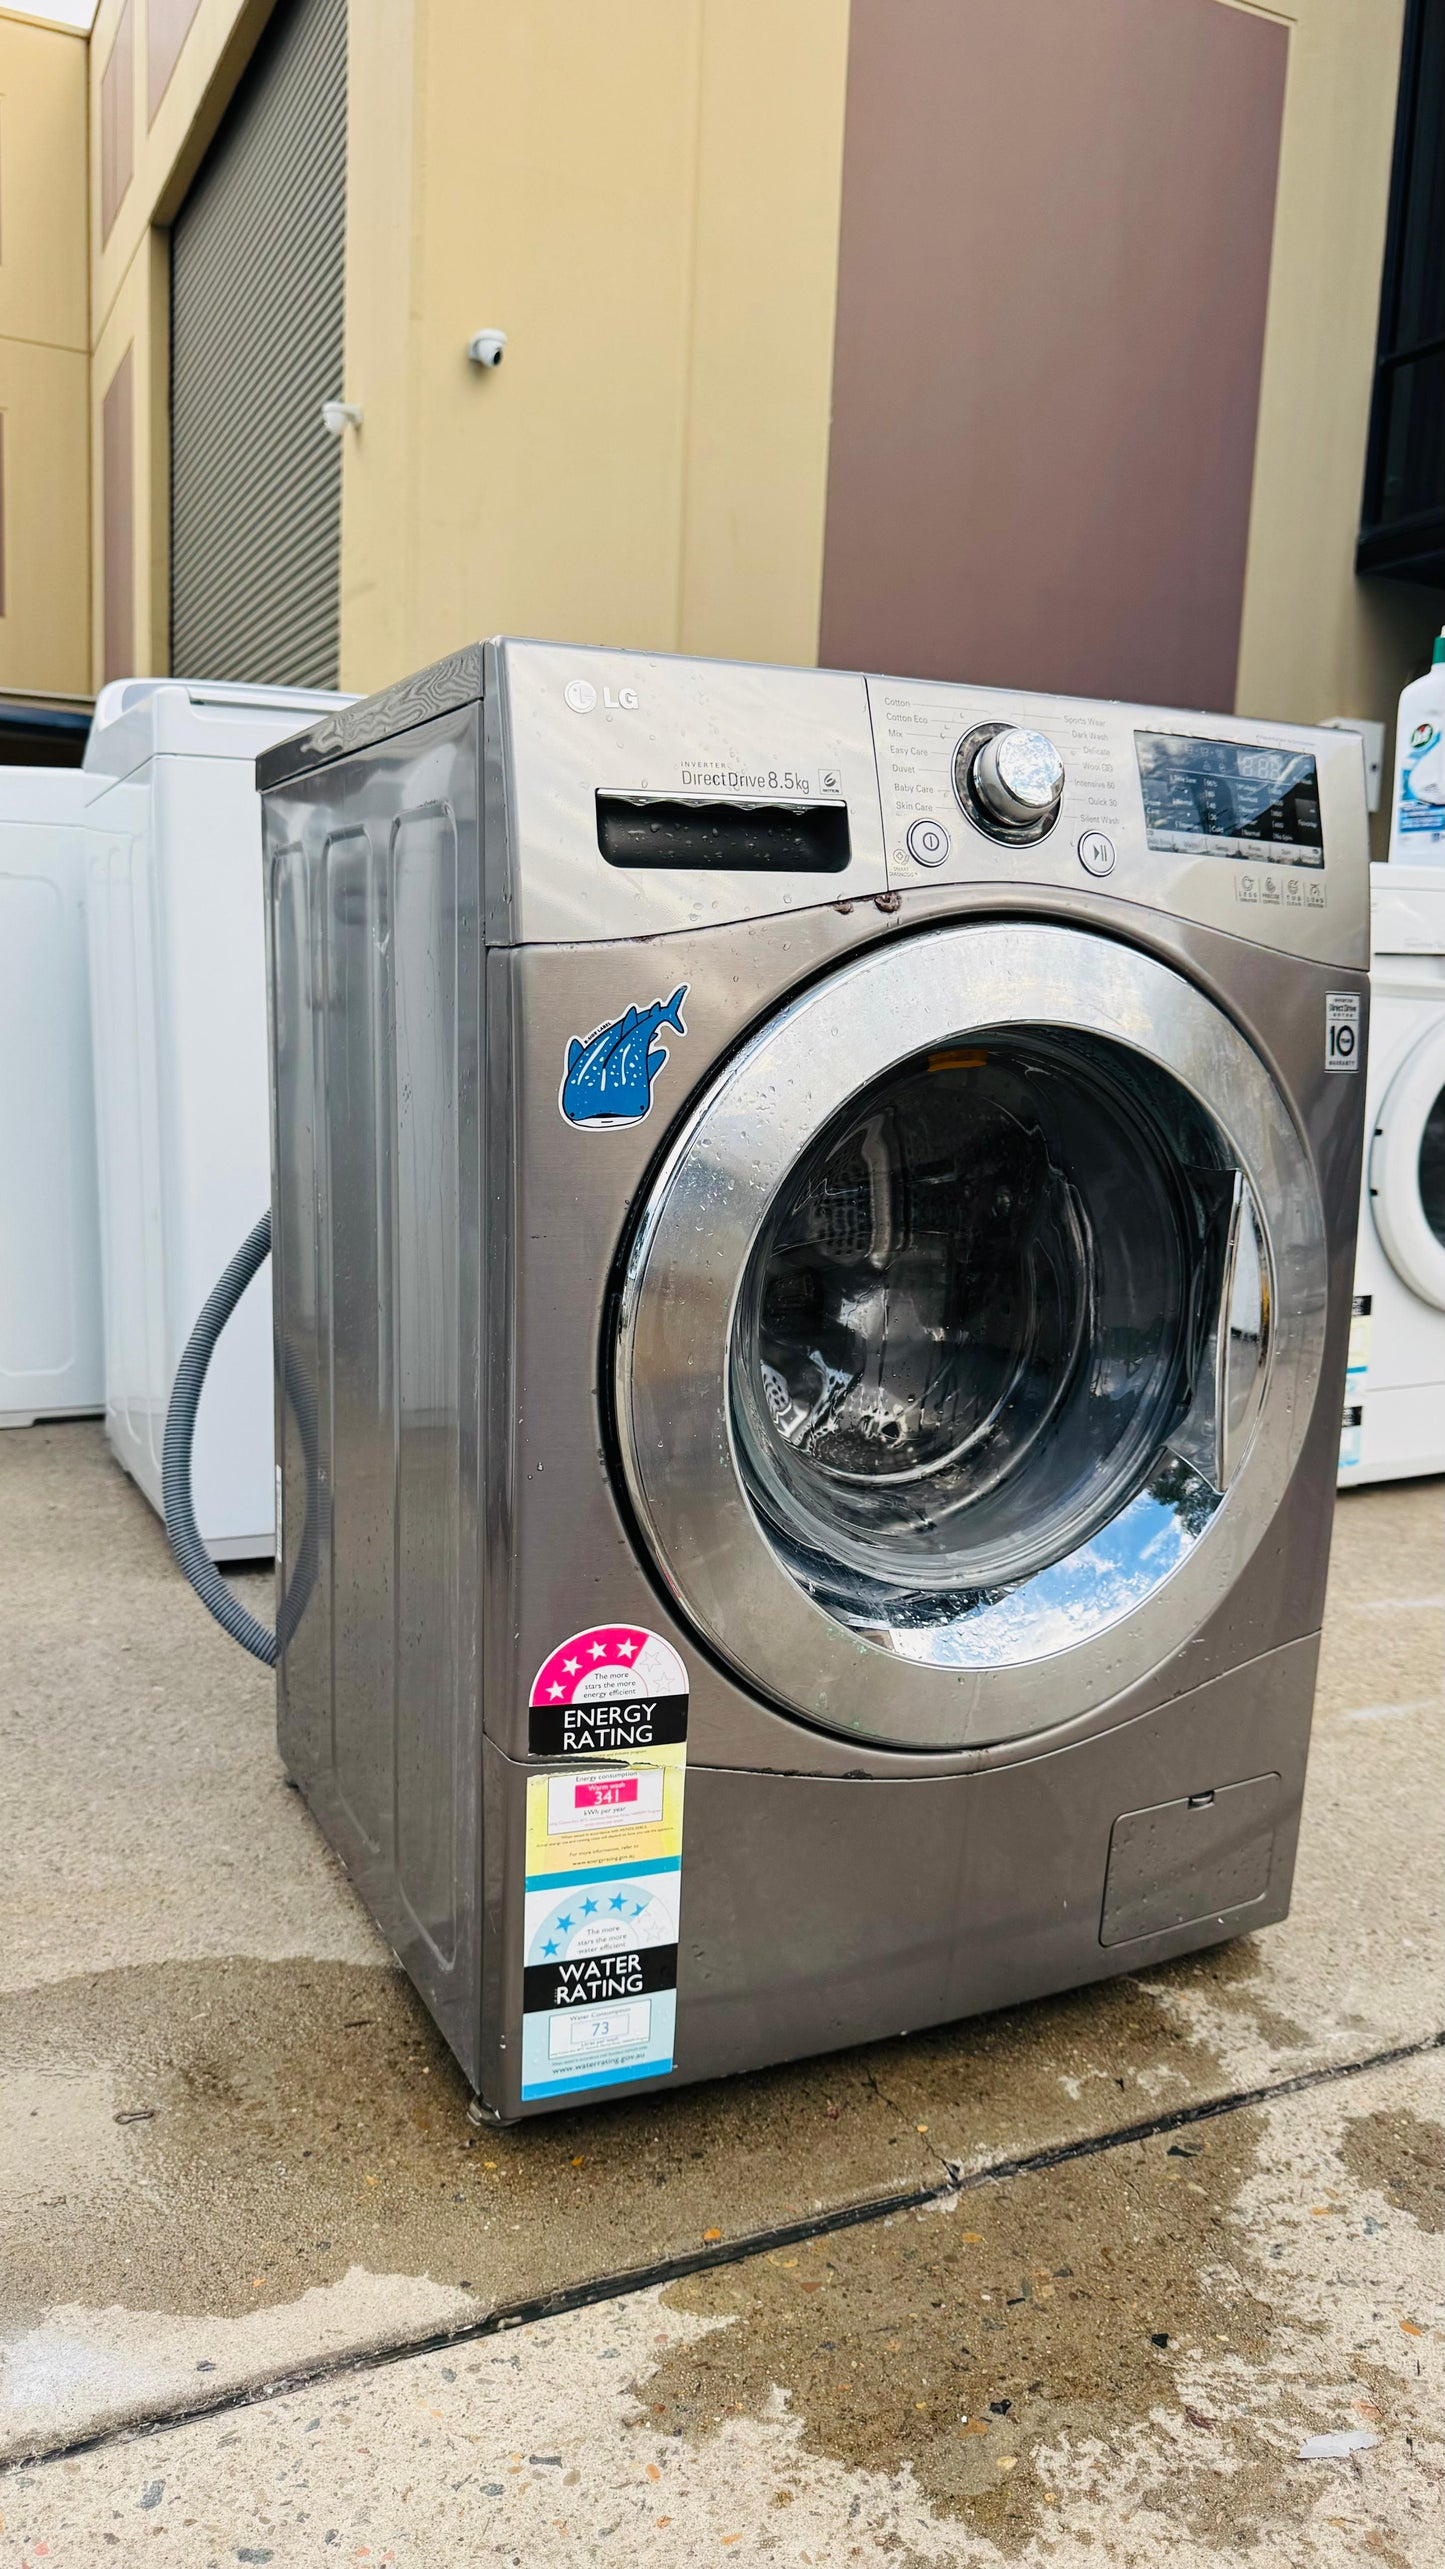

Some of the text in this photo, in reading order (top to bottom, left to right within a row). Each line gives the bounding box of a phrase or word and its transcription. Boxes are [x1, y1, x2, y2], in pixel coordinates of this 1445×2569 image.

[603, 686, 639, 710] LG
[884, 697, 911, 707] Cotton
[886, 712, 928, 724] Cotton Eco
[1063, 715, 1106, 727] Sports Wear
[888, 729, 903, 738] Mix
[1071, 730, 1109, 741] Dark Wash
[890, 745, 929, 756] Easy Care
[1083, 746, 1110, 756] Delicate
[681, 761, 727, 769] INVERTER
[892, 764, 915, 774] Duvet
[1082, 762, 1101, 771] Wool
[894, 783, 934, 794] Baby Care
[1074, 779, 1106, 789] Intensive
[896, 801, 933, 812] Skin Care
[1088, 797, 1118, 807] Quick 30
[1080, 814, 1120, 825] Silent Wash
[597, 1022, 612, 1033] LABEL
[1330, 1025, 1355, 1057] 10
[594, 1672, 608, 1680] The
[584, 1682, 602, 1690] stars
[603, 1681, 616, 1689] the
[583, 1688, 636, 1699] energy efficient
[563, 1702, 658, 1729] ENERGY
[563, 1725, 653, 1751] RATING
[576, 1771, 638, 1783] Energy consumption
[594, 1789, 620, 1806] 341
[583, 1806, 626, 1816] kWh per year
[600, 1942, 626, 1950] efficient
[559, 1954, 642, 1983] WATER
[556, 1974, 644, 2005] RATING
[570, 2013, 589, 2021] Water
[592, 2021, 610, 2036] 73
[552, 2053, 645, 2074] www.waterrating.gov.au
